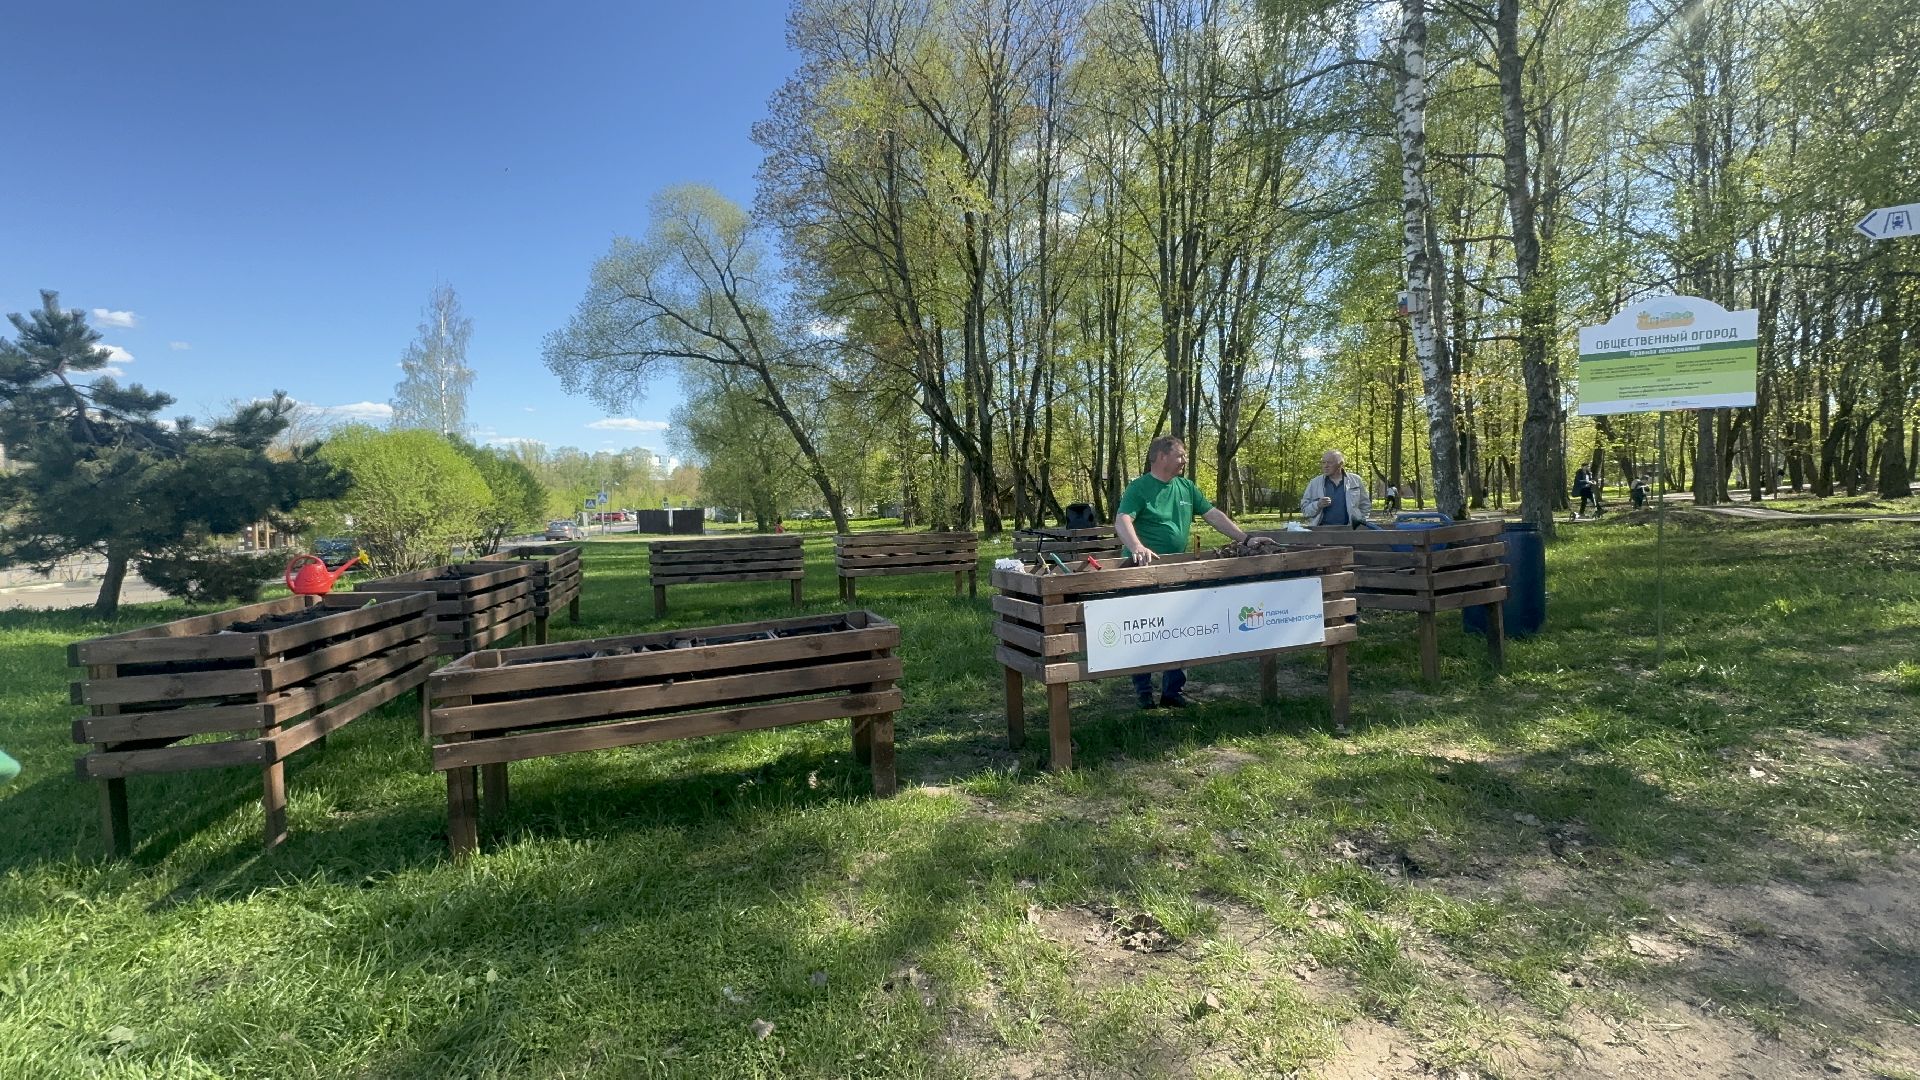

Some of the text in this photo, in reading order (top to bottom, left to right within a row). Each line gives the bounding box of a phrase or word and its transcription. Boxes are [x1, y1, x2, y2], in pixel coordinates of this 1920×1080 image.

[1595, 327, 1738, 350] ОБЩЕСТВЕННЫЙ ОГОРОД
[1630, 349, 1657, 357] Правила
[1265, 609, 1289, 617] ПАРКИ
[1265, 613, 1323, 626] СОЛНЕЧНОГОРЬЯ
[1123, 616, 1165, 631] ПАРКИ
[1124, 623, 1220, 645] ПОДМОСКОВЬЯ
